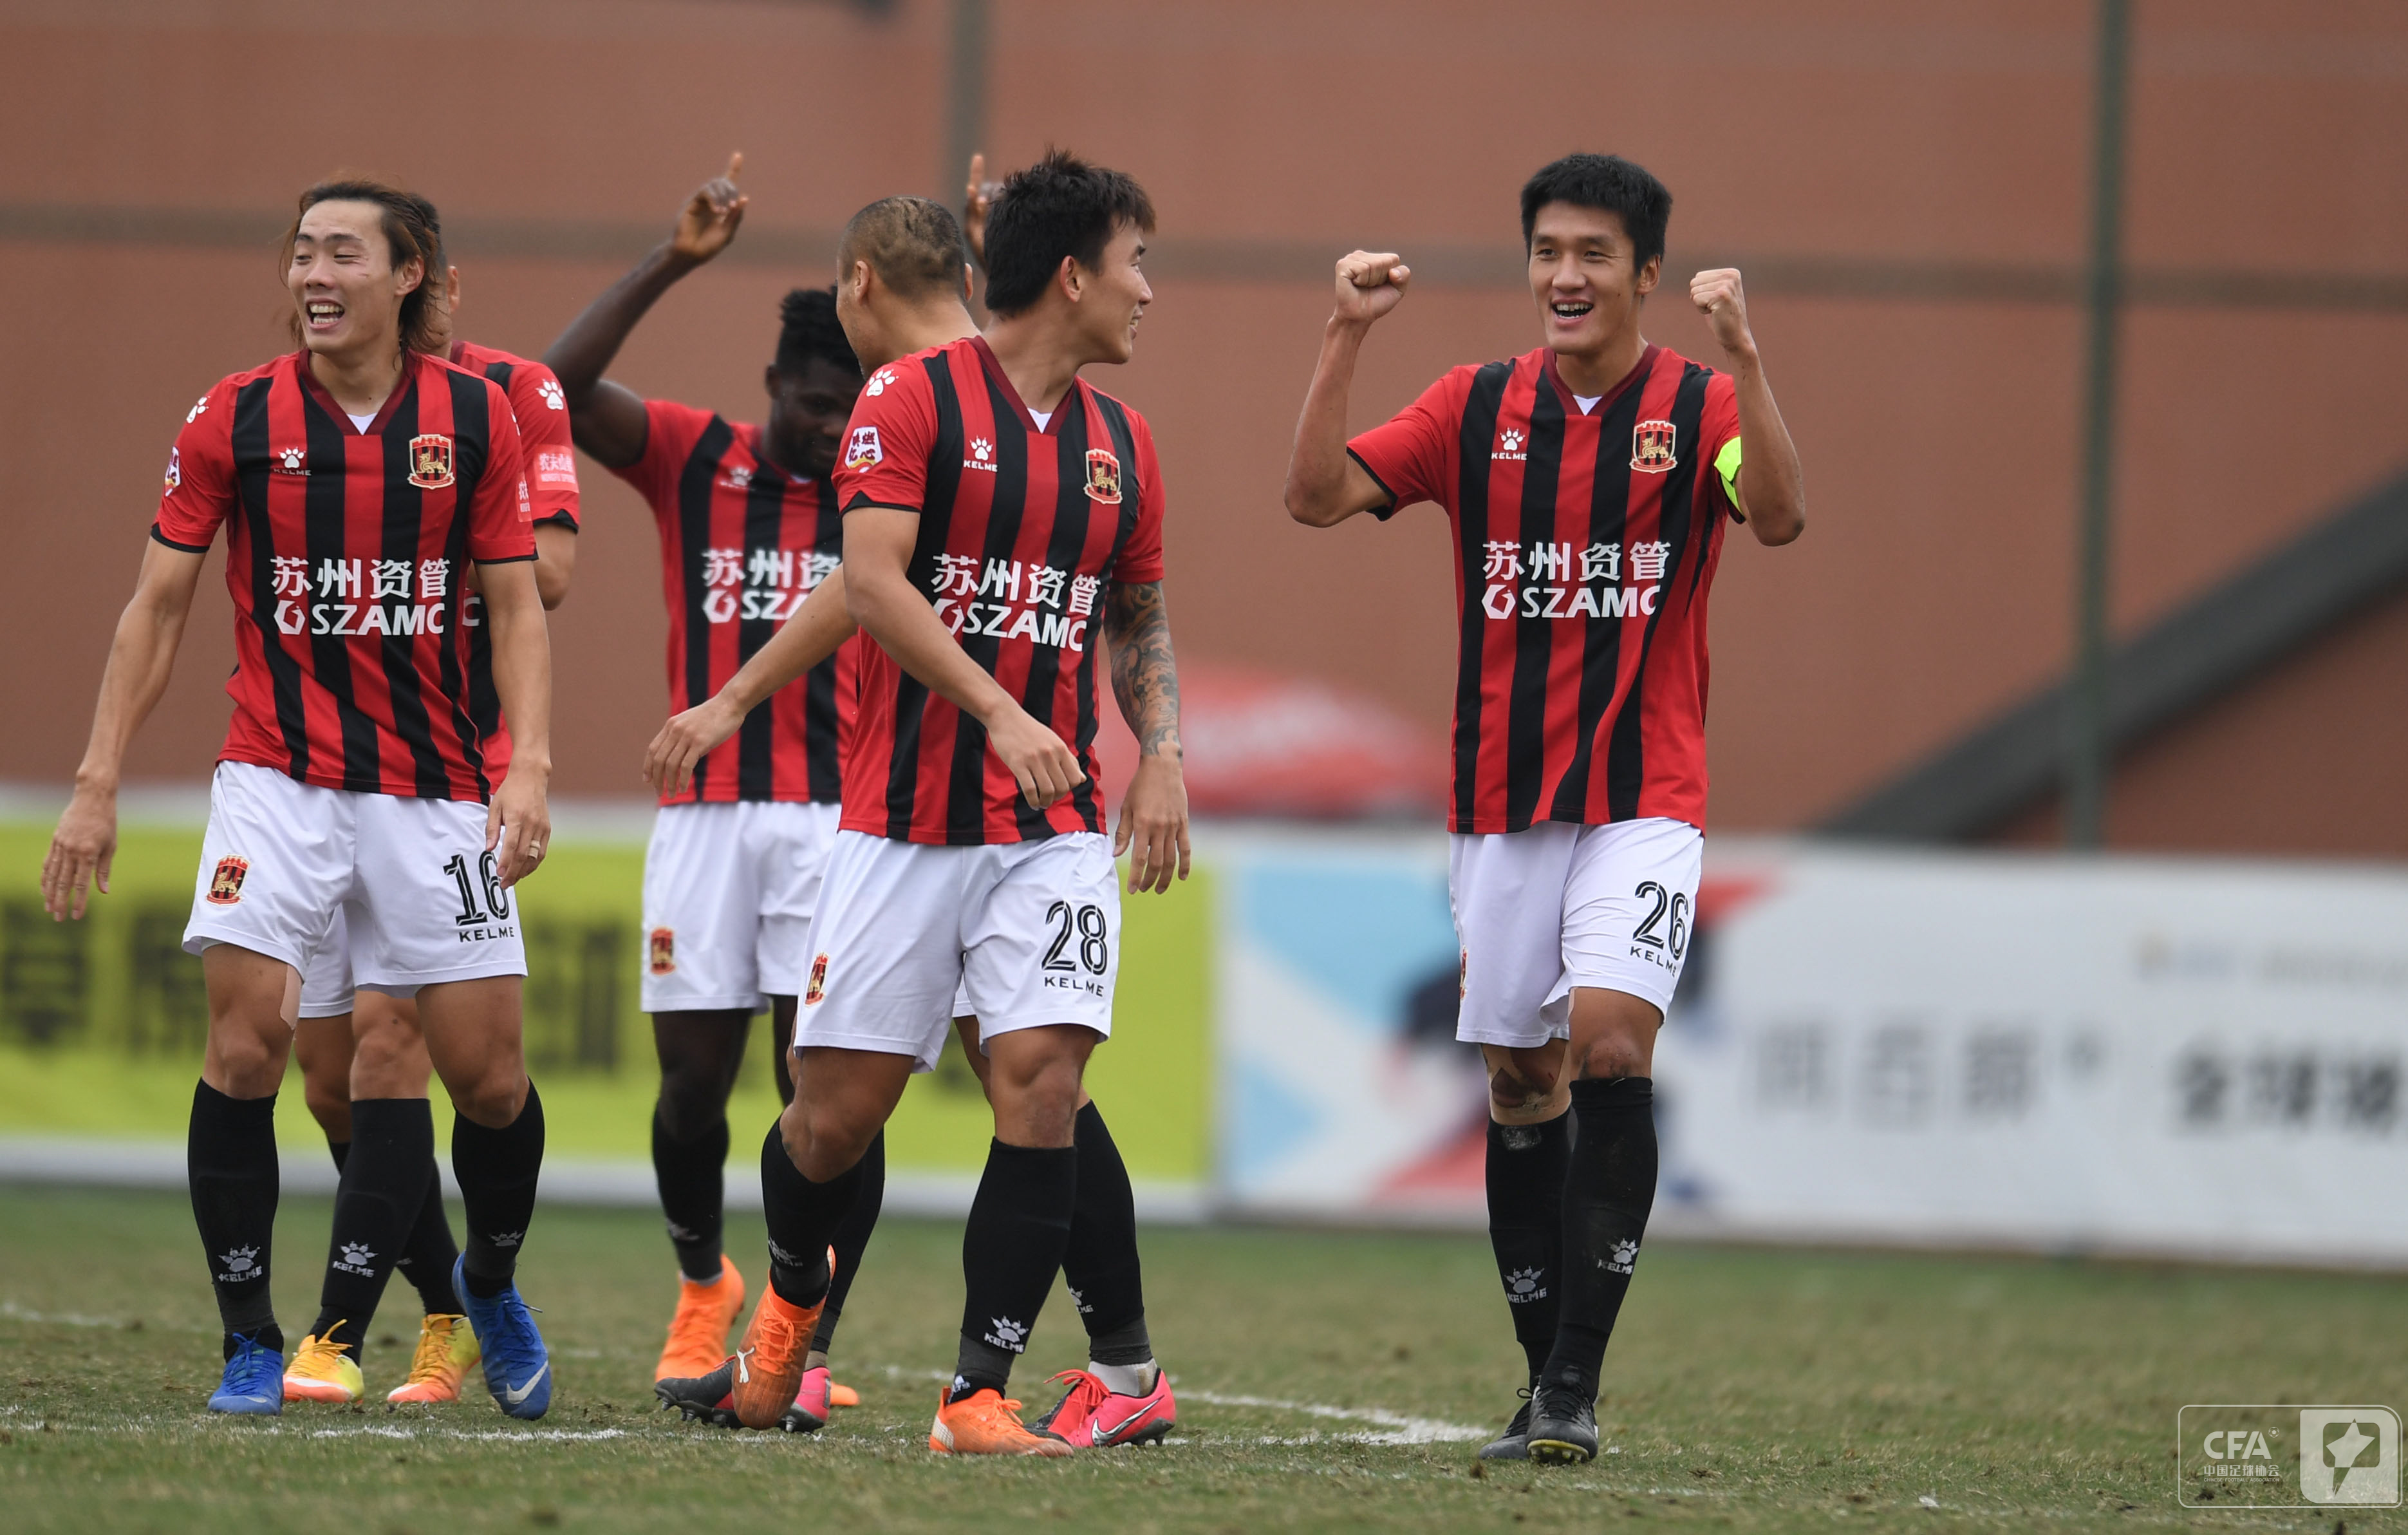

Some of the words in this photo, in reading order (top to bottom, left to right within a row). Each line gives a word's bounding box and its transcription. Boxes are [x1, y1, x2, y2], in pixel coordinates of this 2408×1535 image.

[964, 459, 998, 473] KELME
[1491, 452, 1527, 460] KELME
[270, 556, 451, 599] 苏州资管
[1482, 540, 1672, 582] 苏州资管
[931, 552, 1101, 616] 苏州资管
[1521, 584, 1661, 619] SZAMC
[311, 603, 445, 636] SZAMC
[962, 601, 1087, 652] SZAMC
[443, 849, 510, 927] 16
[459, 927, 515, 943] KELME
[1632, 880, 1688, 961] 26
[1041, 900, 1108, 976] 28
[1630, 946, 1677, 978] KELME
[1044, 976, 1104, 997] KELME
[218, 1265, 263, 1283] KELME
[333, 1261, 375, 1277] KELME
[1507, 1287, 1547, 1304] KELME
